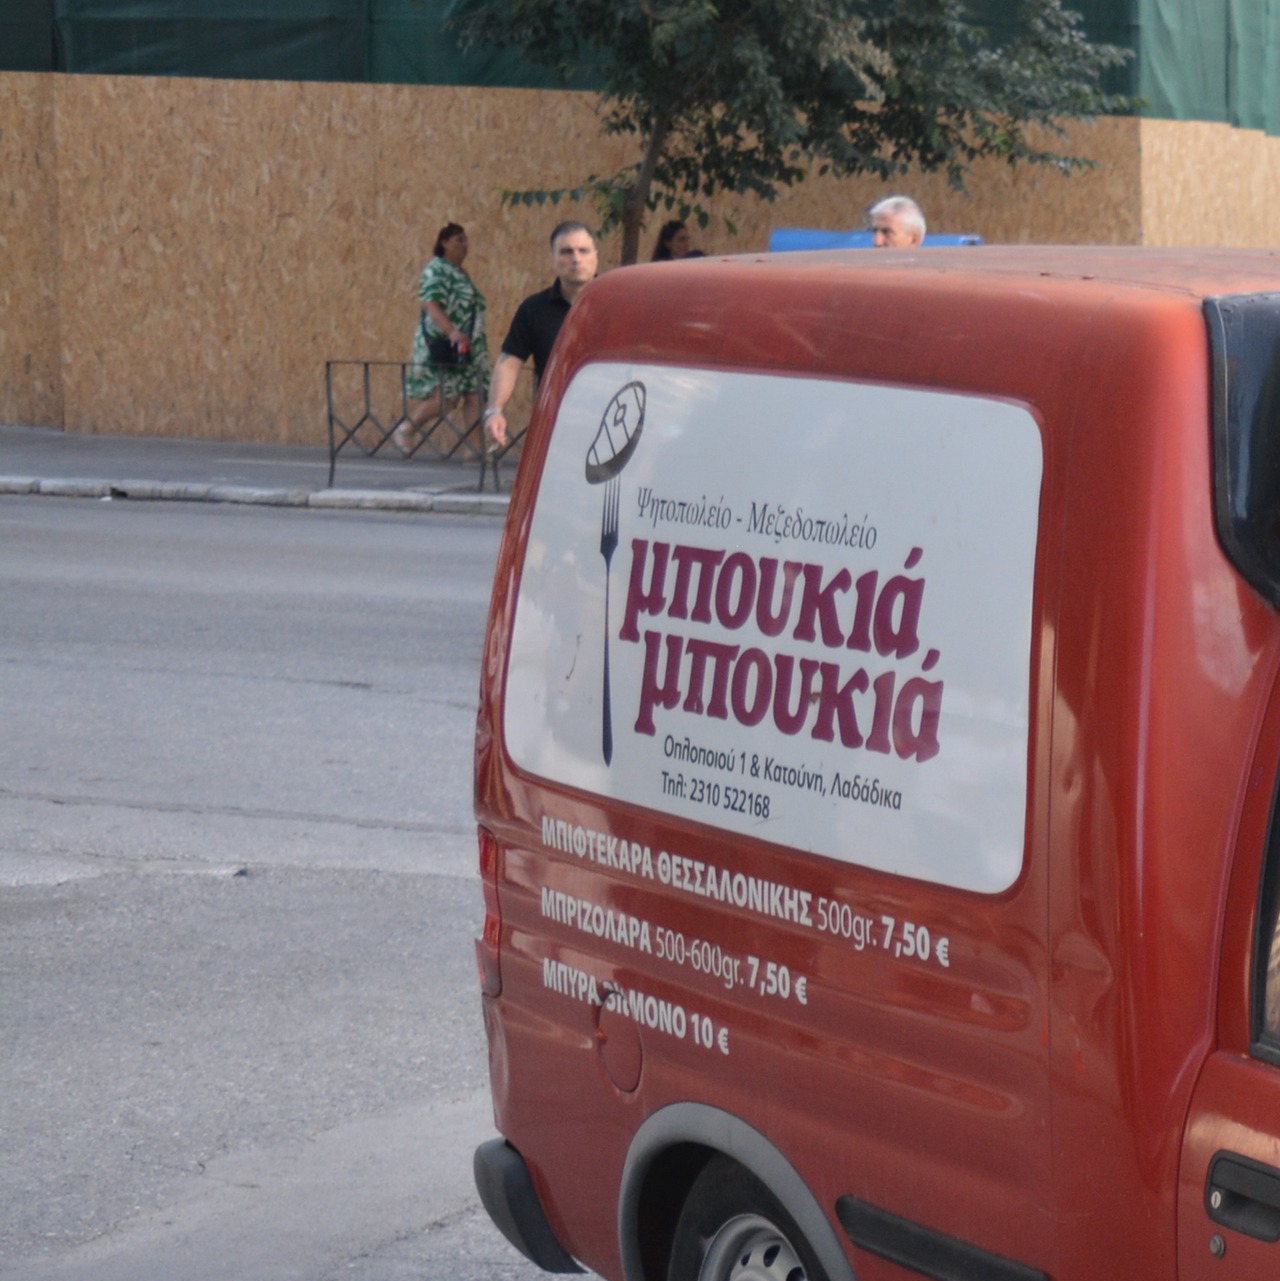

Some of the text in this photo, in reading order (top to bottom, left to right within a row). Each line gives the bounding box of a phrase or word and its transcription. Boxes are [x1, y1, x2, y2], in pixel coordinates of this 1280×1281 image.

[637, 486, 732, 531] Ψητοπωλείο
[746, 501, 878, 550] Μεζεδοπωλείο
[619, 538, 926, 660] μπουκιά
[634, 648, 944, 763] μπουκιά
[661, 771, 771, 819] Τηλ: 2310 522168
[663, 734, 903, 810] Οπλοποιού 1 & Κατούνη, Λαδάδικα
[541, 815, 950, 968] ΜΠΙΦΤΕΚΑΡΑ ΘΕΣΣΑΛΟΝΙΚΗΣ 500gr. 7,50 €
[541, 886, 808, 1005] ΜΠΡΙΖΟΛΑΡΑ 500-600gr. 7,50 €
[543, 957, 603, 1007] ΜΠΥΡΑ
[629, 988, 687, 1039] ΜΟΝΟ
[691, 1012, 714, 1050] 10
[717, 1026, 730, 1056] €
